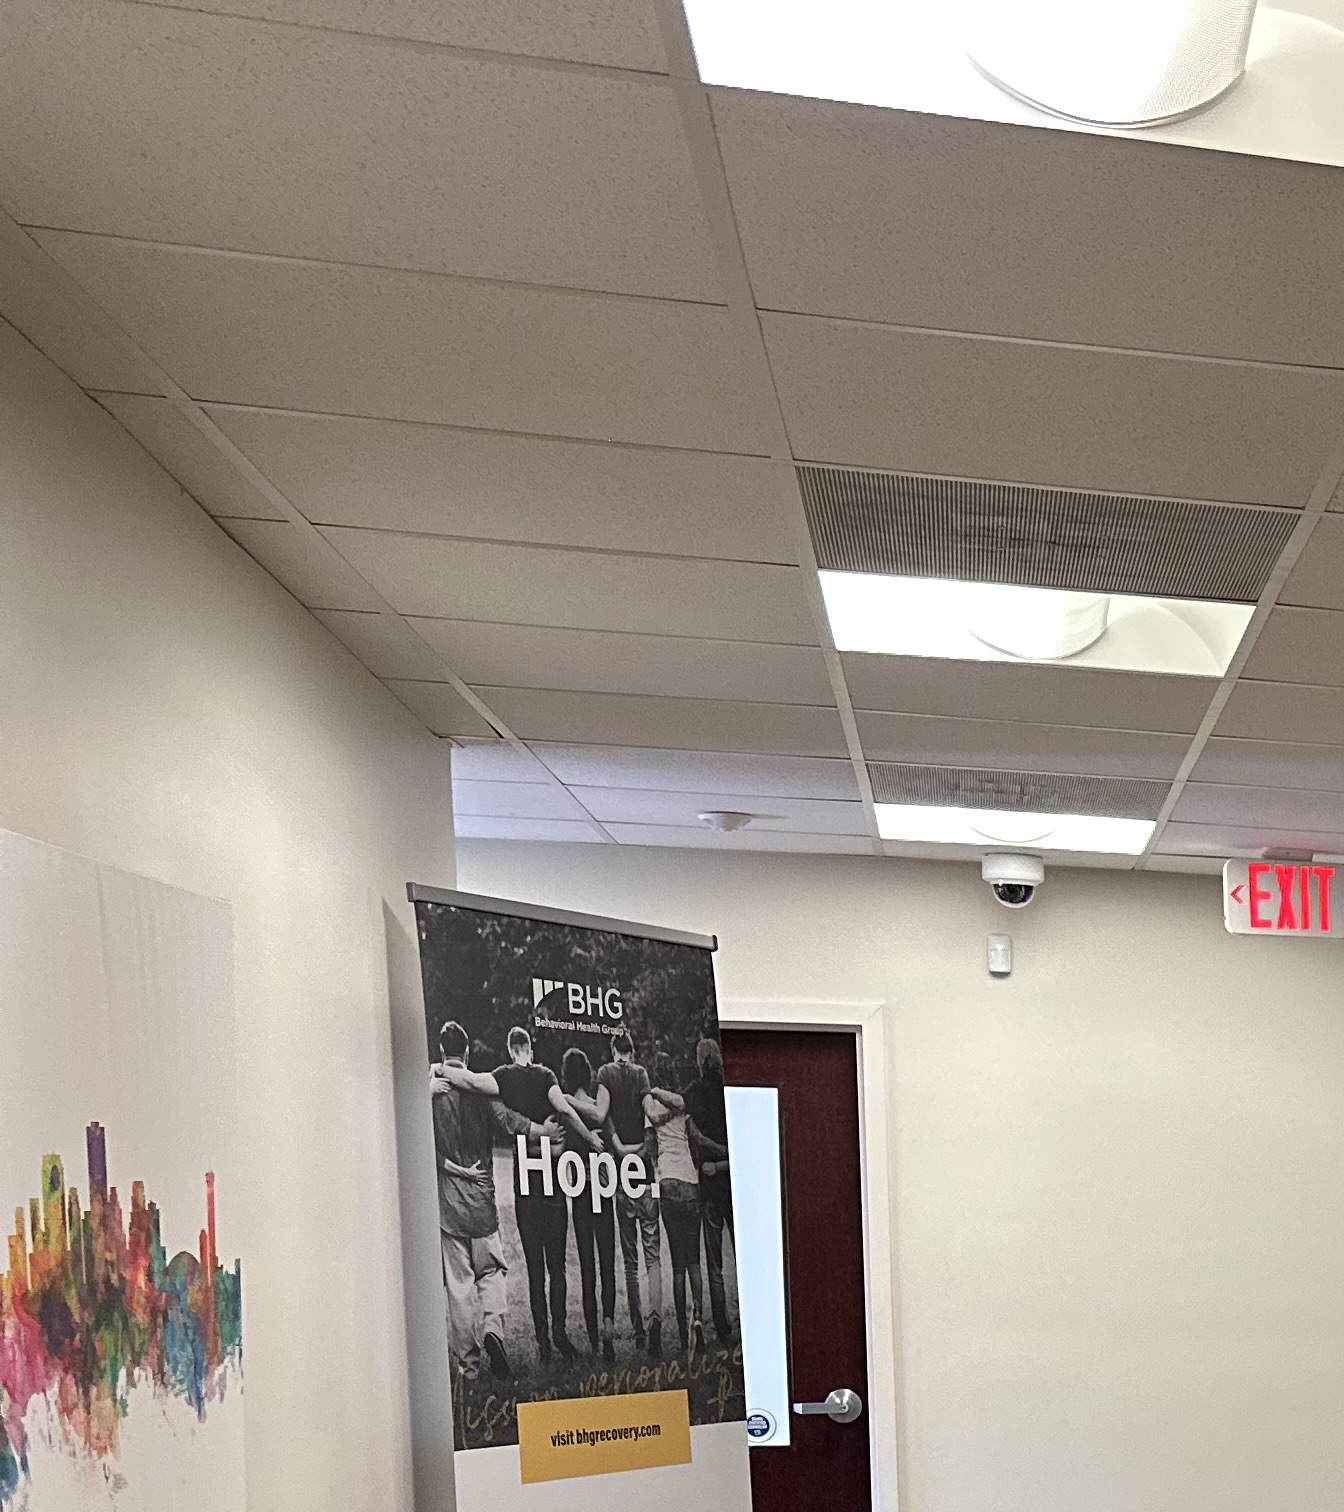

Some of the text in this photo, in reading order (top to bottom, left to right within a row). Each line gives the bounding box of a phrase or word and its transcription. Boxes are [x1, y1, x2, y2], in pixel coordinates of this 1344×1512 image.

[1248, 862, 1336, 932] EXIT
[568, 983, 622, 1019] BHG
[535, 1017, 575, 1030] Behavioral
[577, 1021, 600, 1033] Health
[517, 1134, 661, 1213] Hope.
[551, 1424, 661, 1447] visit bhgrecovery.com
